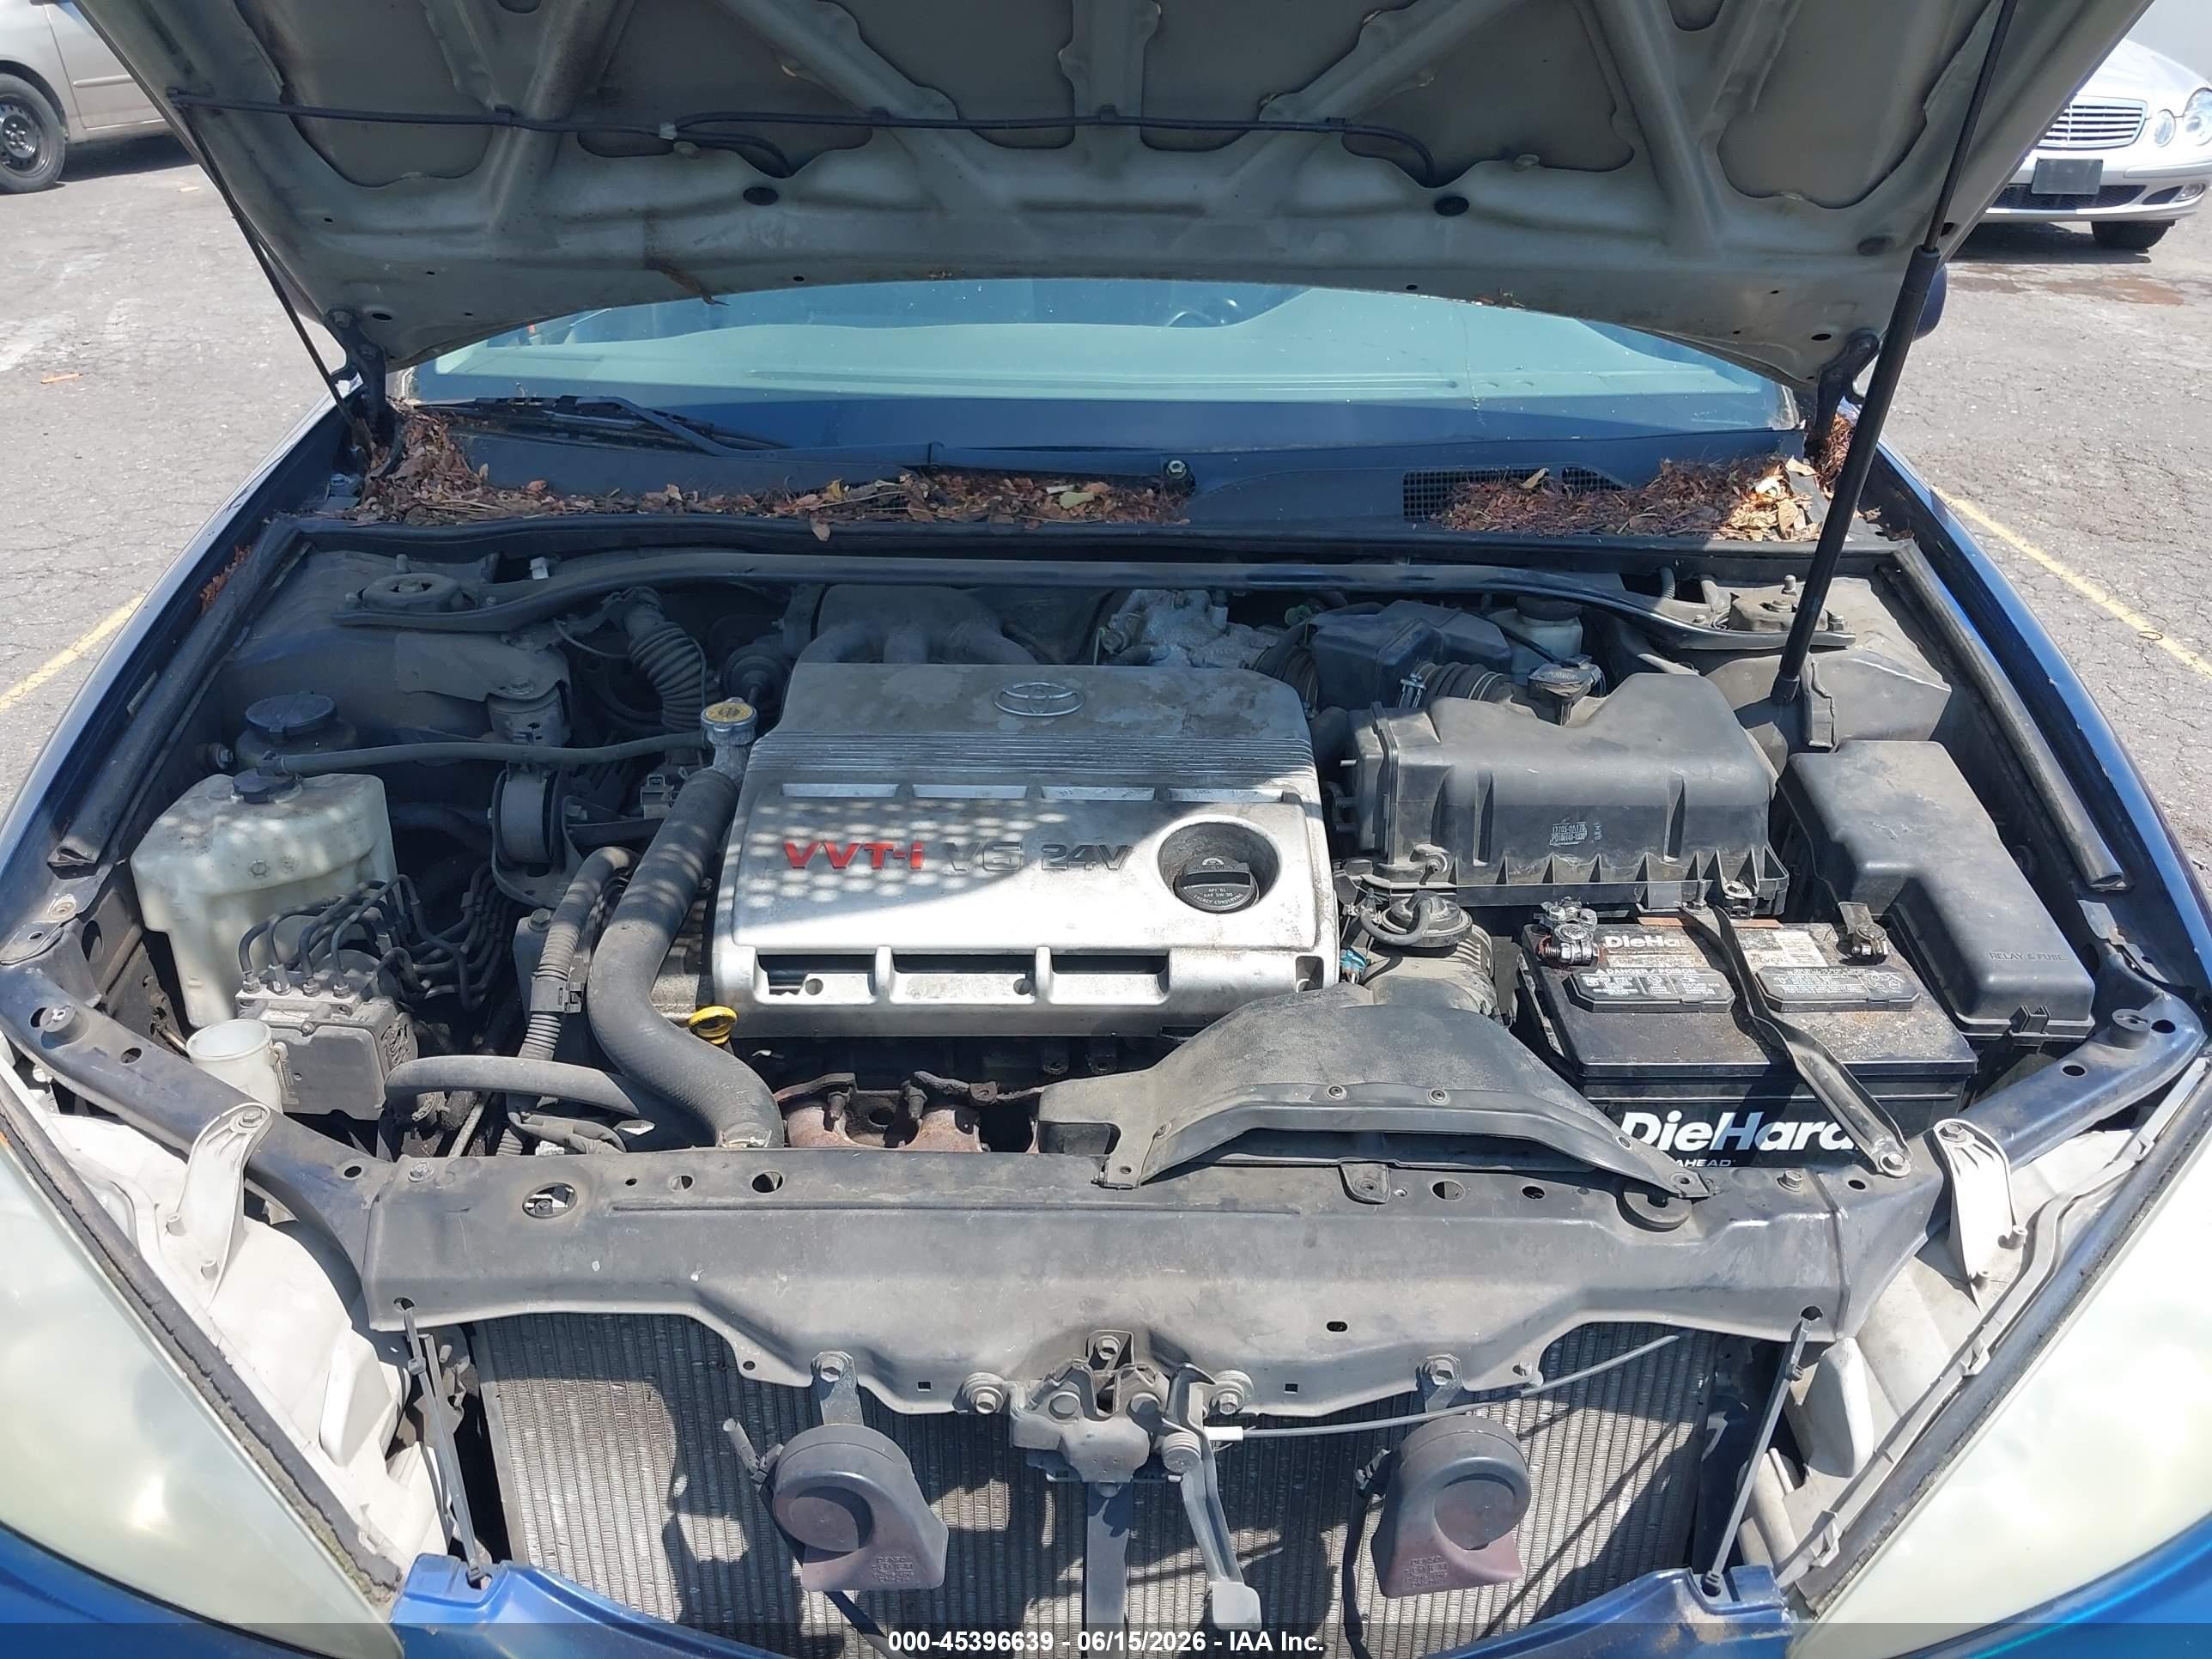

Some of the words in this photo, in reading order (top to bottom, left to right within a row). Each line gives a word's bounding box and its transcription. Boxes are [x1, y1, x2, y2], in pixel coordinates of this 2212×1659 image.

[783, 841, 926, 870] VVT-i
[944, 841, 1024, 872] V6
[1041, 843, 1135, 872] 24V
[1989, 951, 2023, 960] RELAY
